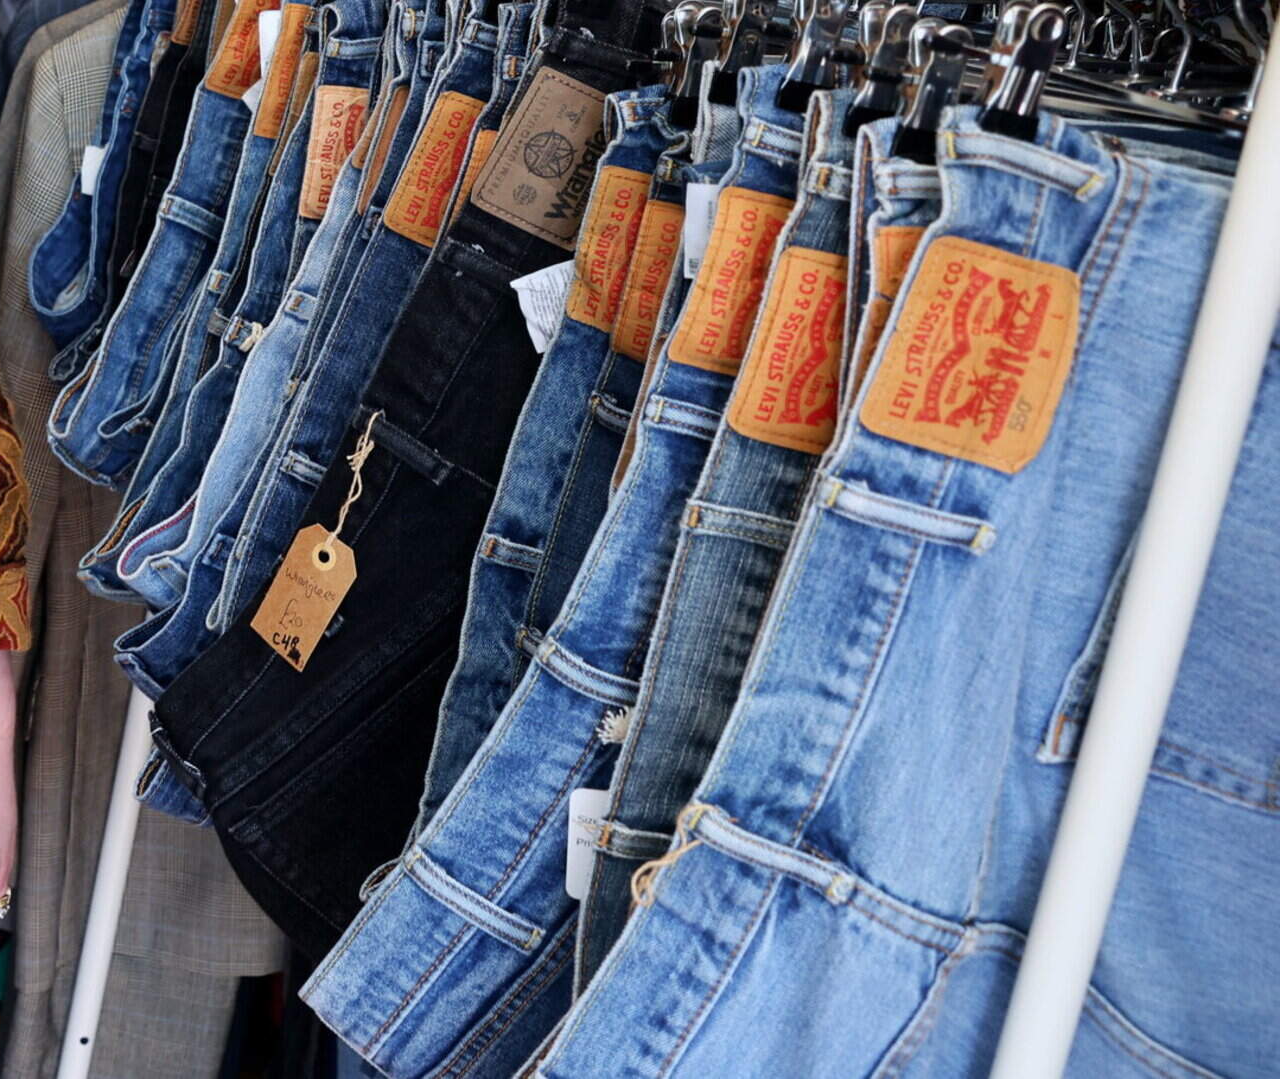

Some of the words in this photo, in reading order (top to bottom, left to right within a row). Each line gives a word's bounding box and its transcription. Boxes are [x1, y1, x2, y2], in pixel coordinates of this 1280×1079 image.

[317, 184, 333, 212] LEVI
[403, 195, 425, 224] LEVI
[416, 140, 449, 192] STRAUSS
[590, 223, 620, 286] STRAUSS
[943, 258, 966, 286] CO.
[584, 287, 602, 318] LEVI
[640, 258, 668, 322] STRAUSS
[696, 322, 723, 355] LEVI
[711, 249, 746, 319] STRAUSS
[937, 287, 954, 300] &
[631, 323, 653, 355] LEVI
[905, 300, 946, 377] STRAUSS
[753, 386, 780, 422] LEVI
[768, 312, 801, 383] STRAUSS
[889, 380, 918, 420] LEVI
